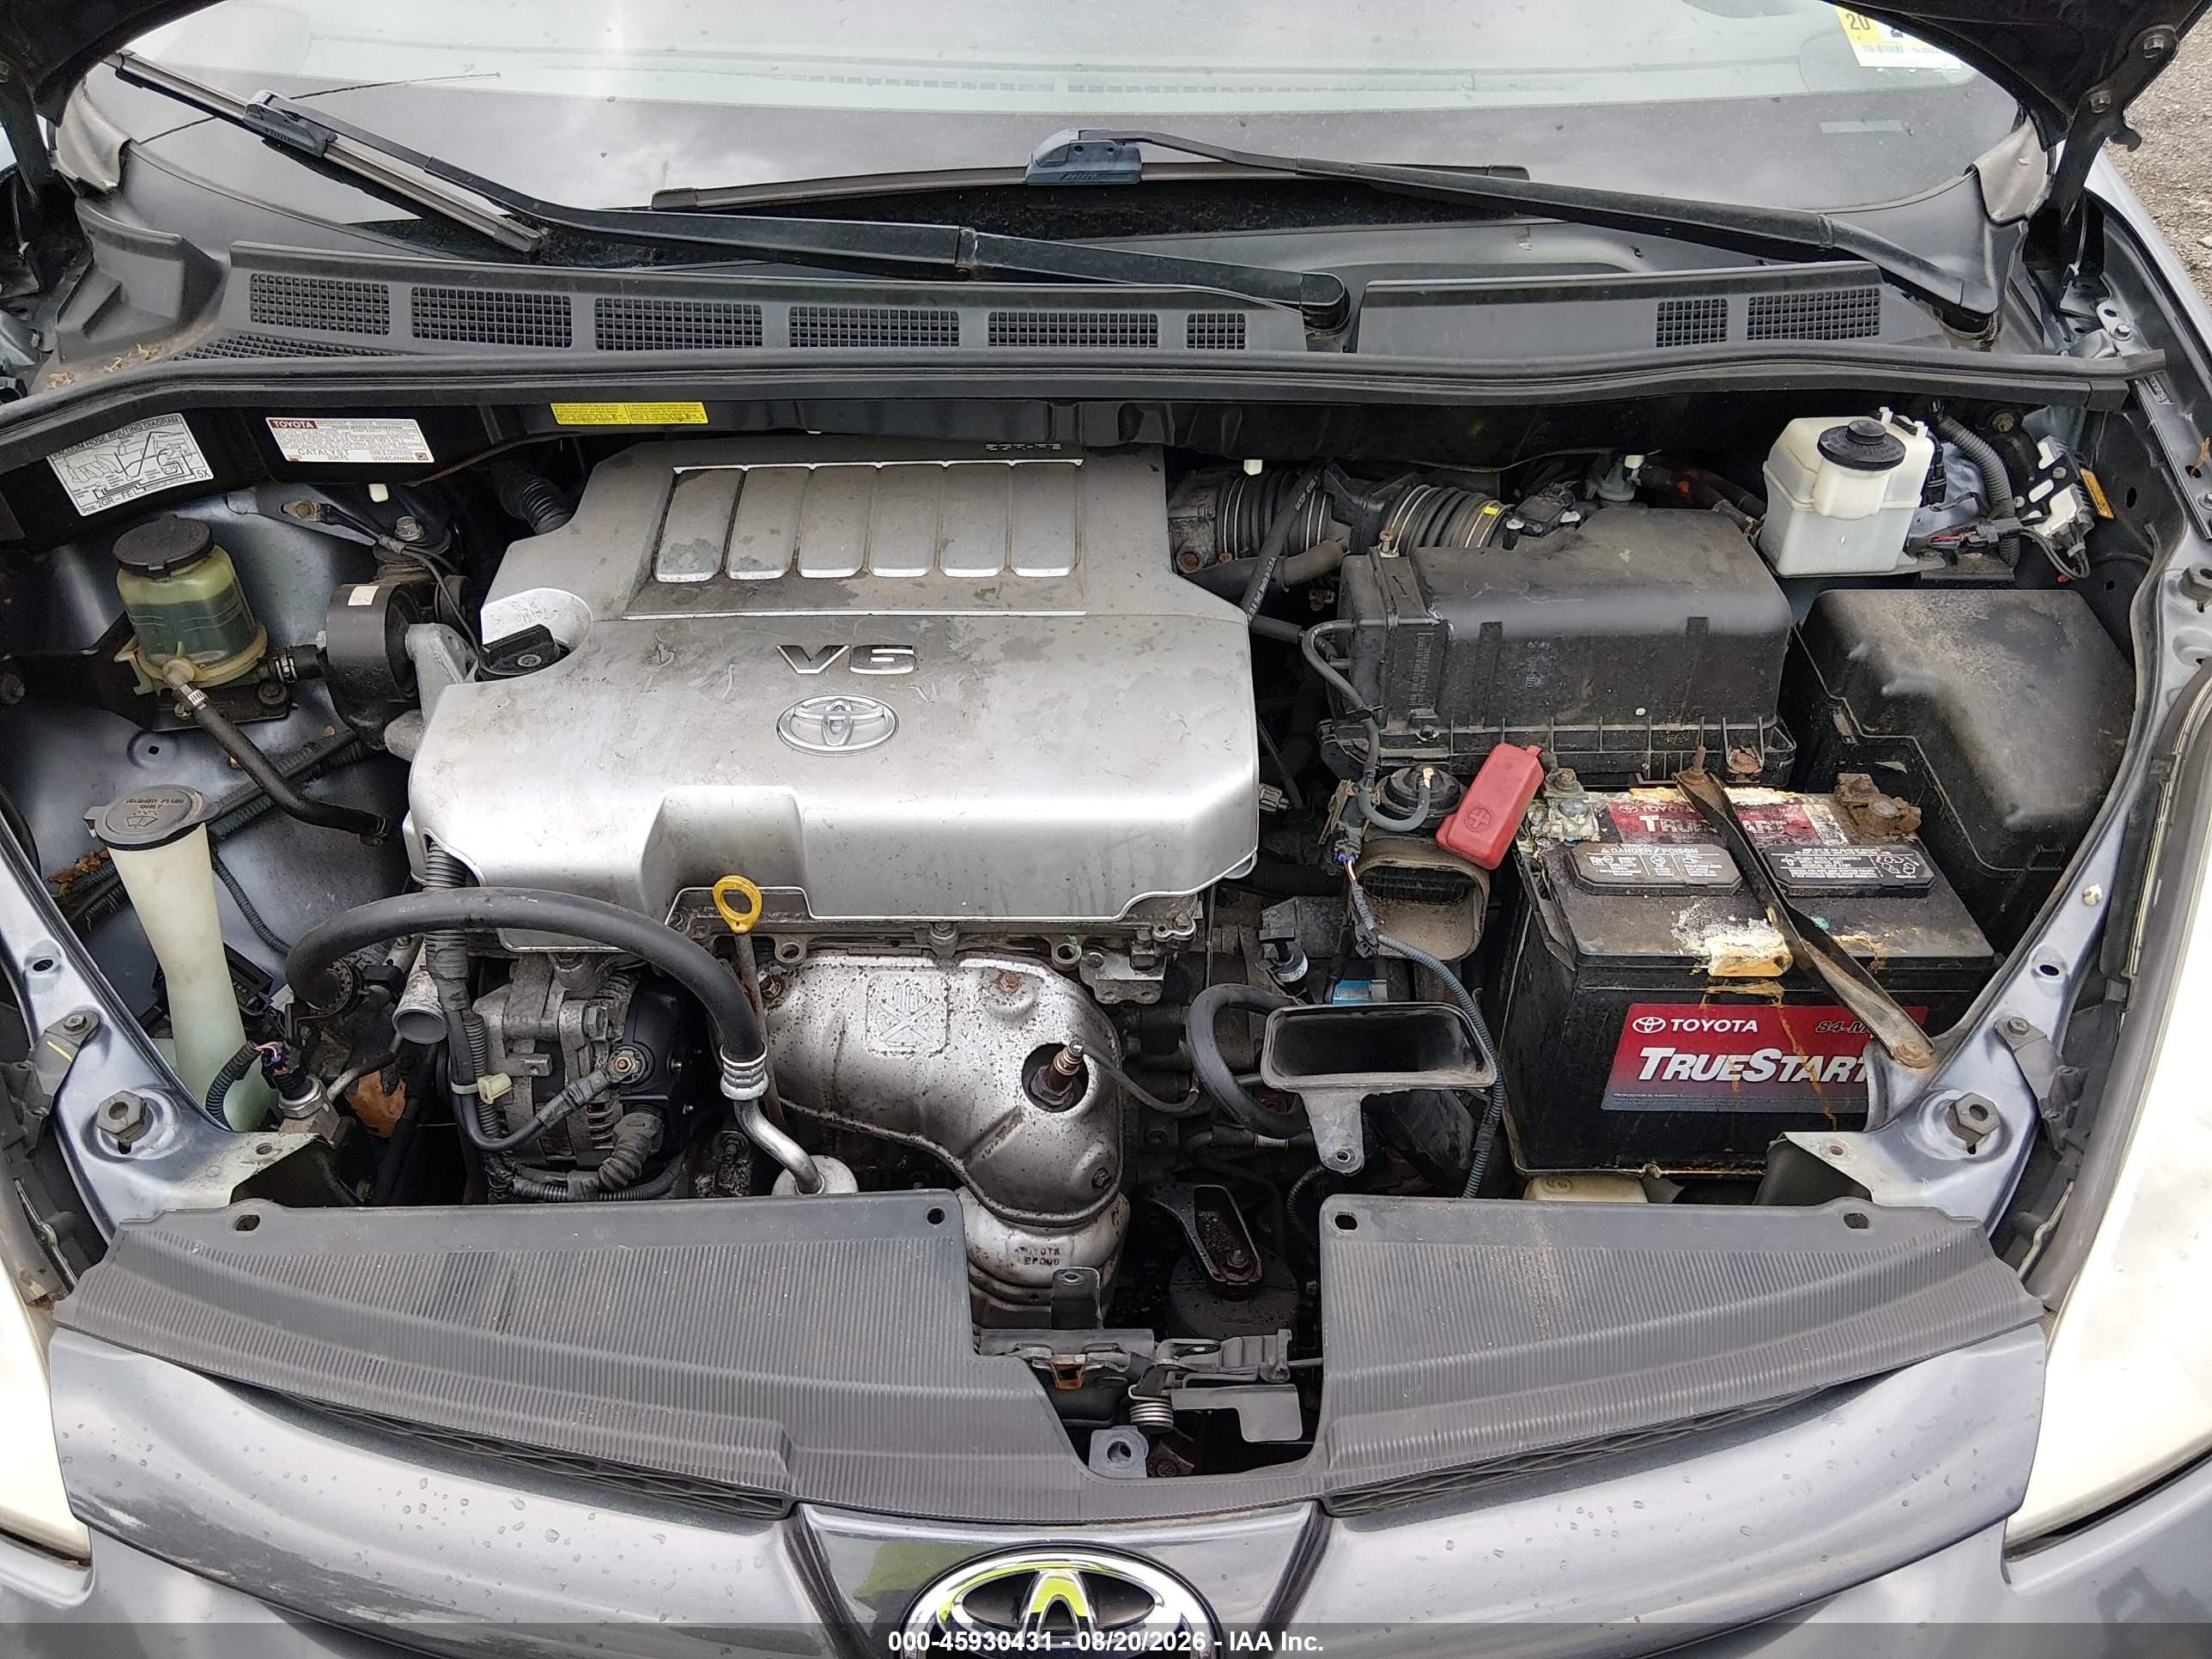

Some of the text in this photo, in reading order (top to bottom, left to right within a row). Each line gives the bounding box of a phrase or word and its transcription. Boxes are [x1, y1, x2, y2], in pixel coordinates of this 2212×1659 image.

[52, 444, 86, 459] VACUUM
[86, 434, 108, 448] HOSE
[108, 424, 143, 441] ROUTING
[143, 416, 180, 429] DIAGRAM
[197, 468, 211, 479] 5X
[776, 644, 915, 675] V6
[1670, 1018, 1759, 1032] TOYOTA
